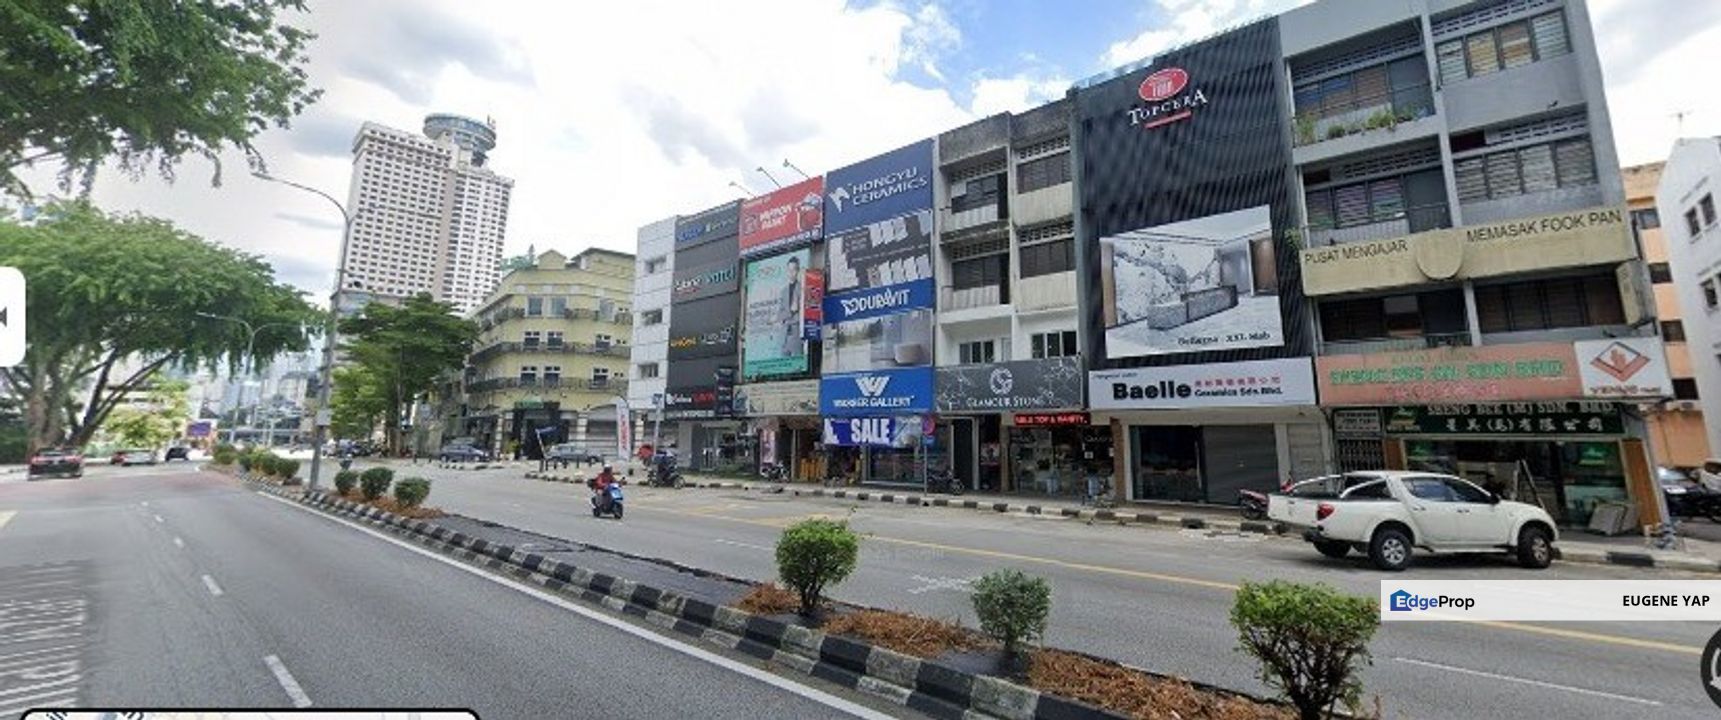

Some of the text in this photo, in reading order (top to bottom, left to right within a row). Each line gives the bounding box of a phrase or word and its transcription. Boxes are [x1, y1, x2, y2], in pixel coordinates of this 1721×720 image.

[852, 166, 917, 195] HONGYU
[852, 176, 928, 205] CERAMICS
[1304, 210, 1622, 264] PUSAT MENGAJAR MEMASAK FOOK PAN
[870, 396, 911, 408] GALLERY
[1112, 380, 1192, 401] Baelle
[851, 417, 890, 445] SALE
